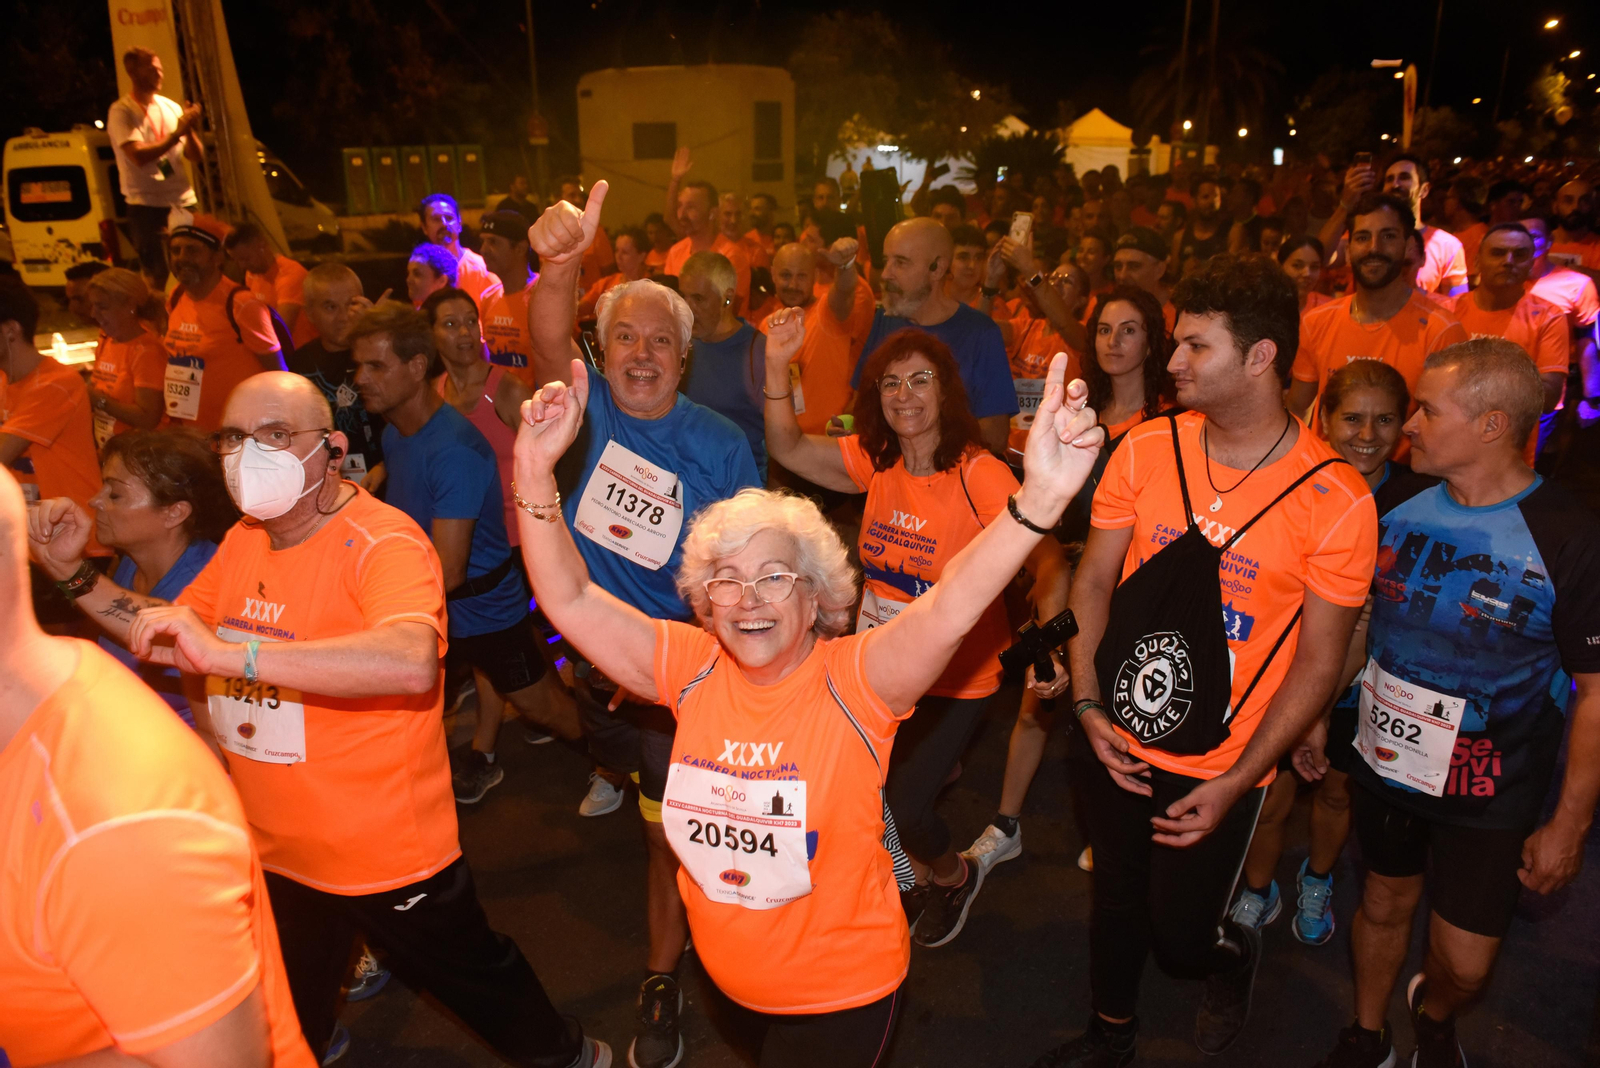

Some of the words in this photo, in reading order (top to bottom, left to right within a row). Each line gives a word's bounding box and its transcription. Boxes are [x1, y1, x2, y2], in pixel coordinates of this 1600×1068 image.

[606, 482, 665, 526] 11378
[591, 497, 604, 508] PEDRO
[603, 505, 622, 518] ANTONIO
[621, 515, 647, 531] ARRECIADO
[646, 527, 667, 539] ARROYO
[889, 509, 928, 532] XXXV
[869, 528, 936, 555] GUADALQUIVIR
[900, 530, 937, 545] NOCTURNA
[634, 551, 661, 566] Cruzcampo
[241, 597, 286, 624] XXXV
[223, 615, 254, 631] CARRERA
[255, 625, 296, 640] NOCTURNA
[224, 677, 281, 710] 19213
[1121, 705, 1180, 737] UNLIKE
[1370, 704, 1422, 745] 5262
[264, 748, 299, 758] Cruzcampo
[716, 738, 784, 767] XXXV
[1380, 735, 1404, 748] DOPIDO
[1404, 744, 1429, 758] BONILLA
[683, 755, 737, 778] CARRERA
[1406, 773, 1436, 790] Cruzcampo
[681, 804, 702, 812] CARRERA
[702, 808, 729, 817] NOCTURNA
[736, 815, 773, 825] GUADALQUIVIR
[687, 818, 778, 858] 20594
